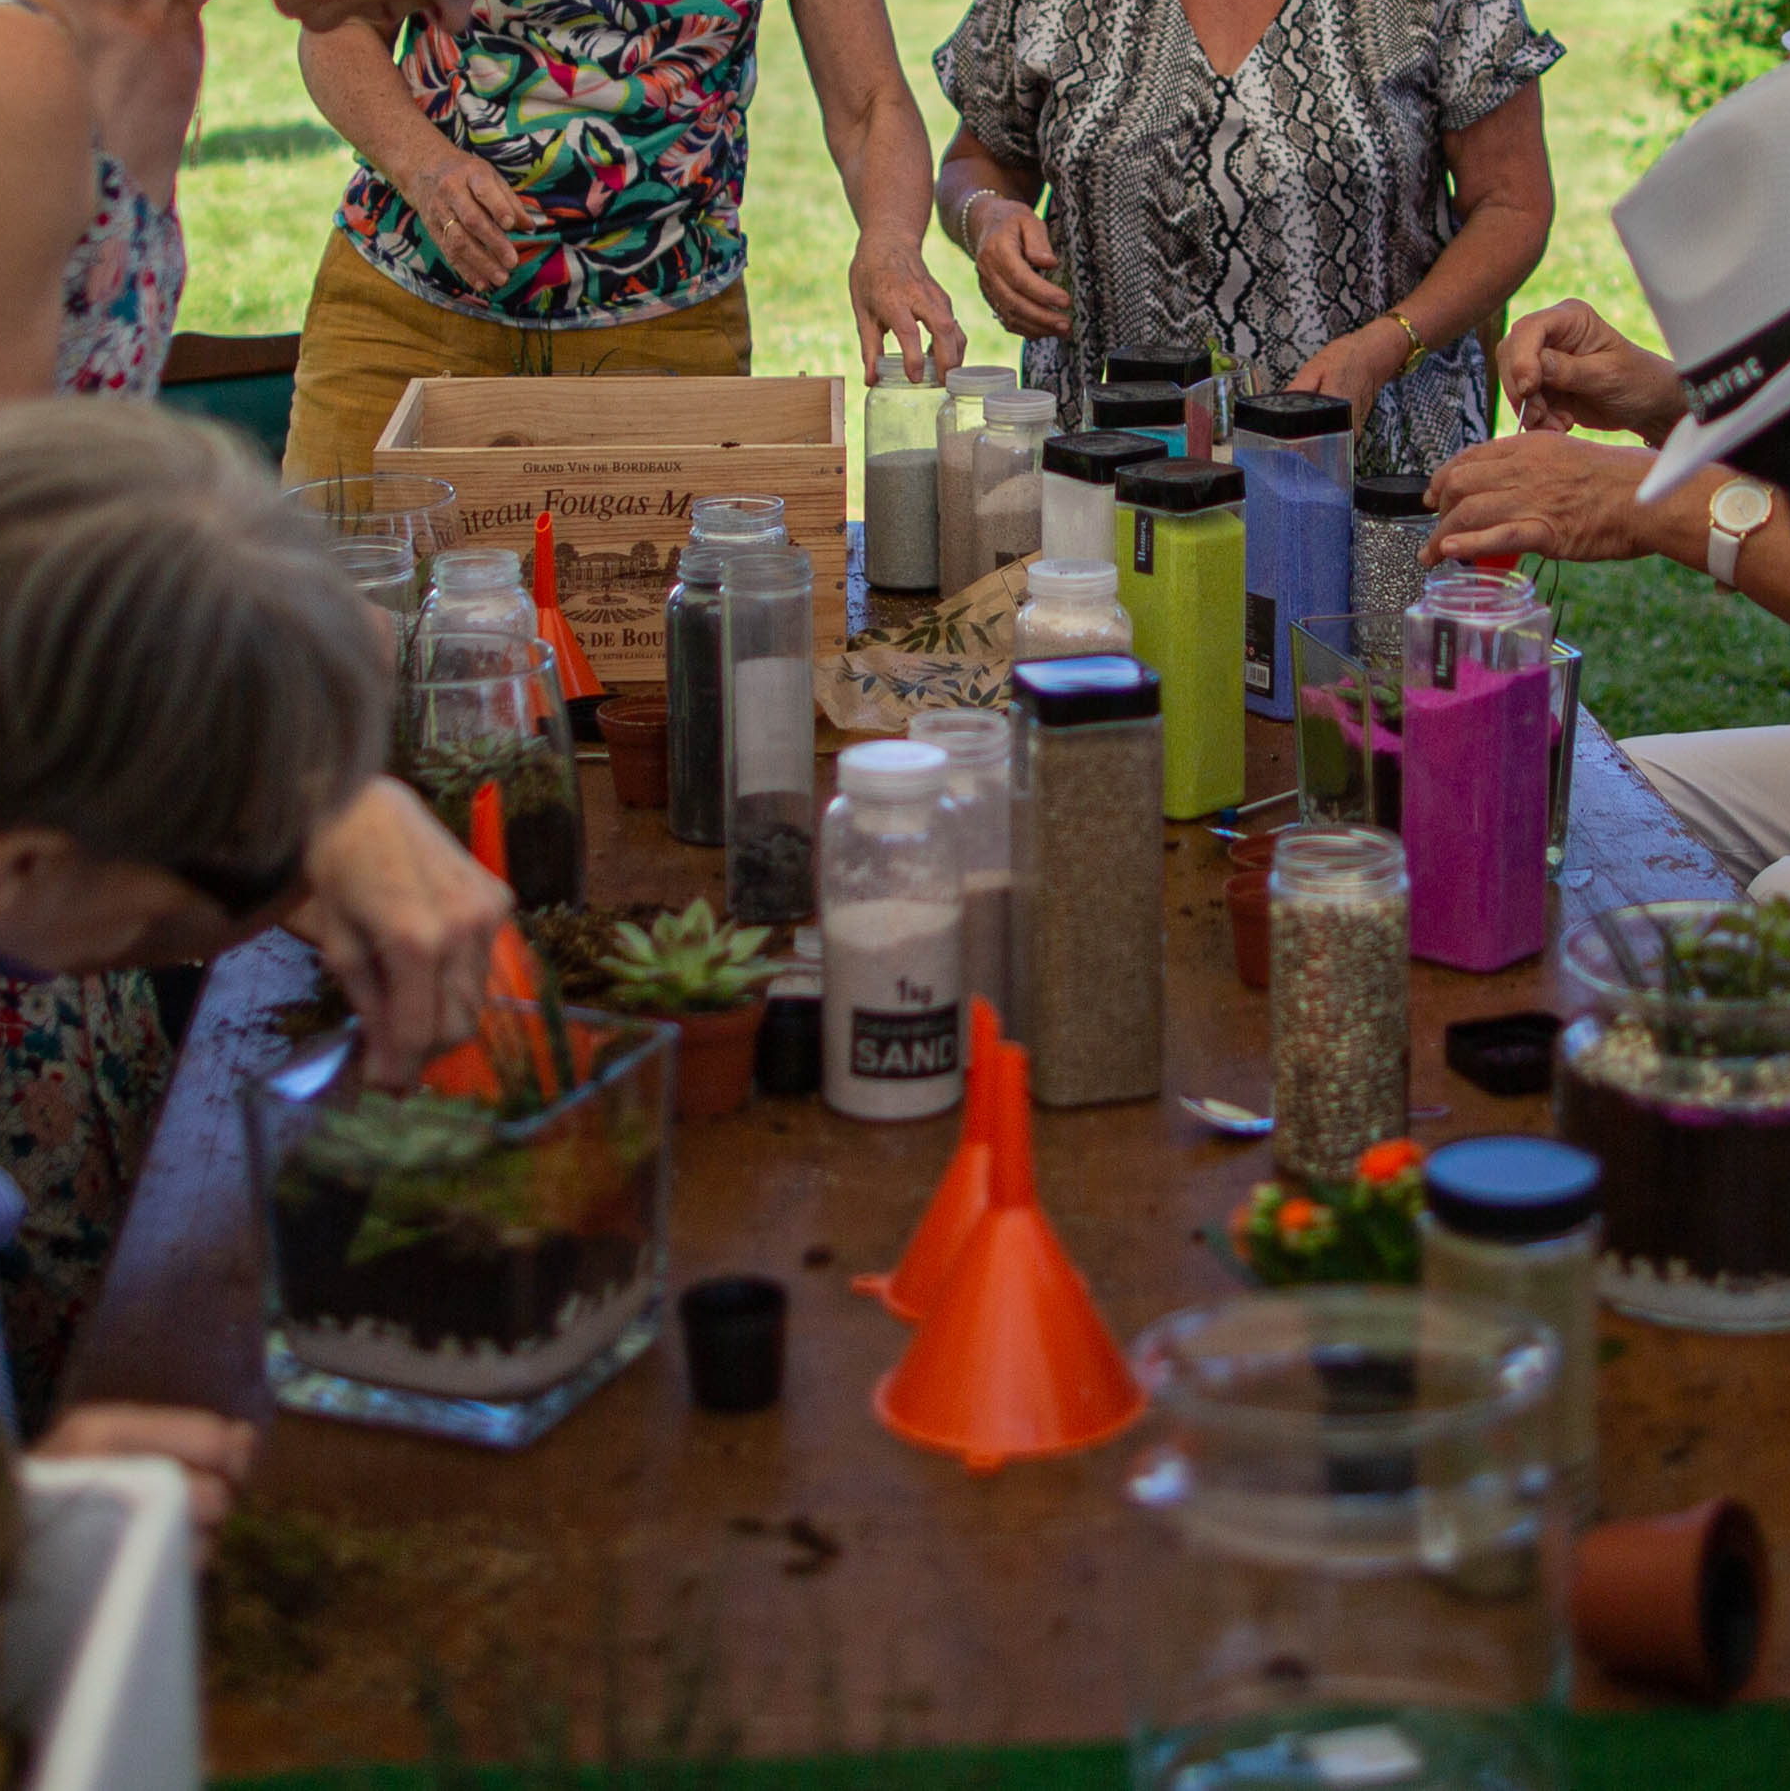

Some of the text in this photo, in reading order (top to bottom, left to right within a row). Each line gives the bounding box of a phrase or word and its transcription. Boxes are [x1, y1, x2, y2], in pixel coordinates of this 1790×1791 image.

[612, 460, 682, 474] BORDEAUX
[545, 488, 650, 522] Fougas
[591, 632, 615, 648] DE
[622, 628, 666, 648] BOU
[856, 1033, 956, 1073] SAND
